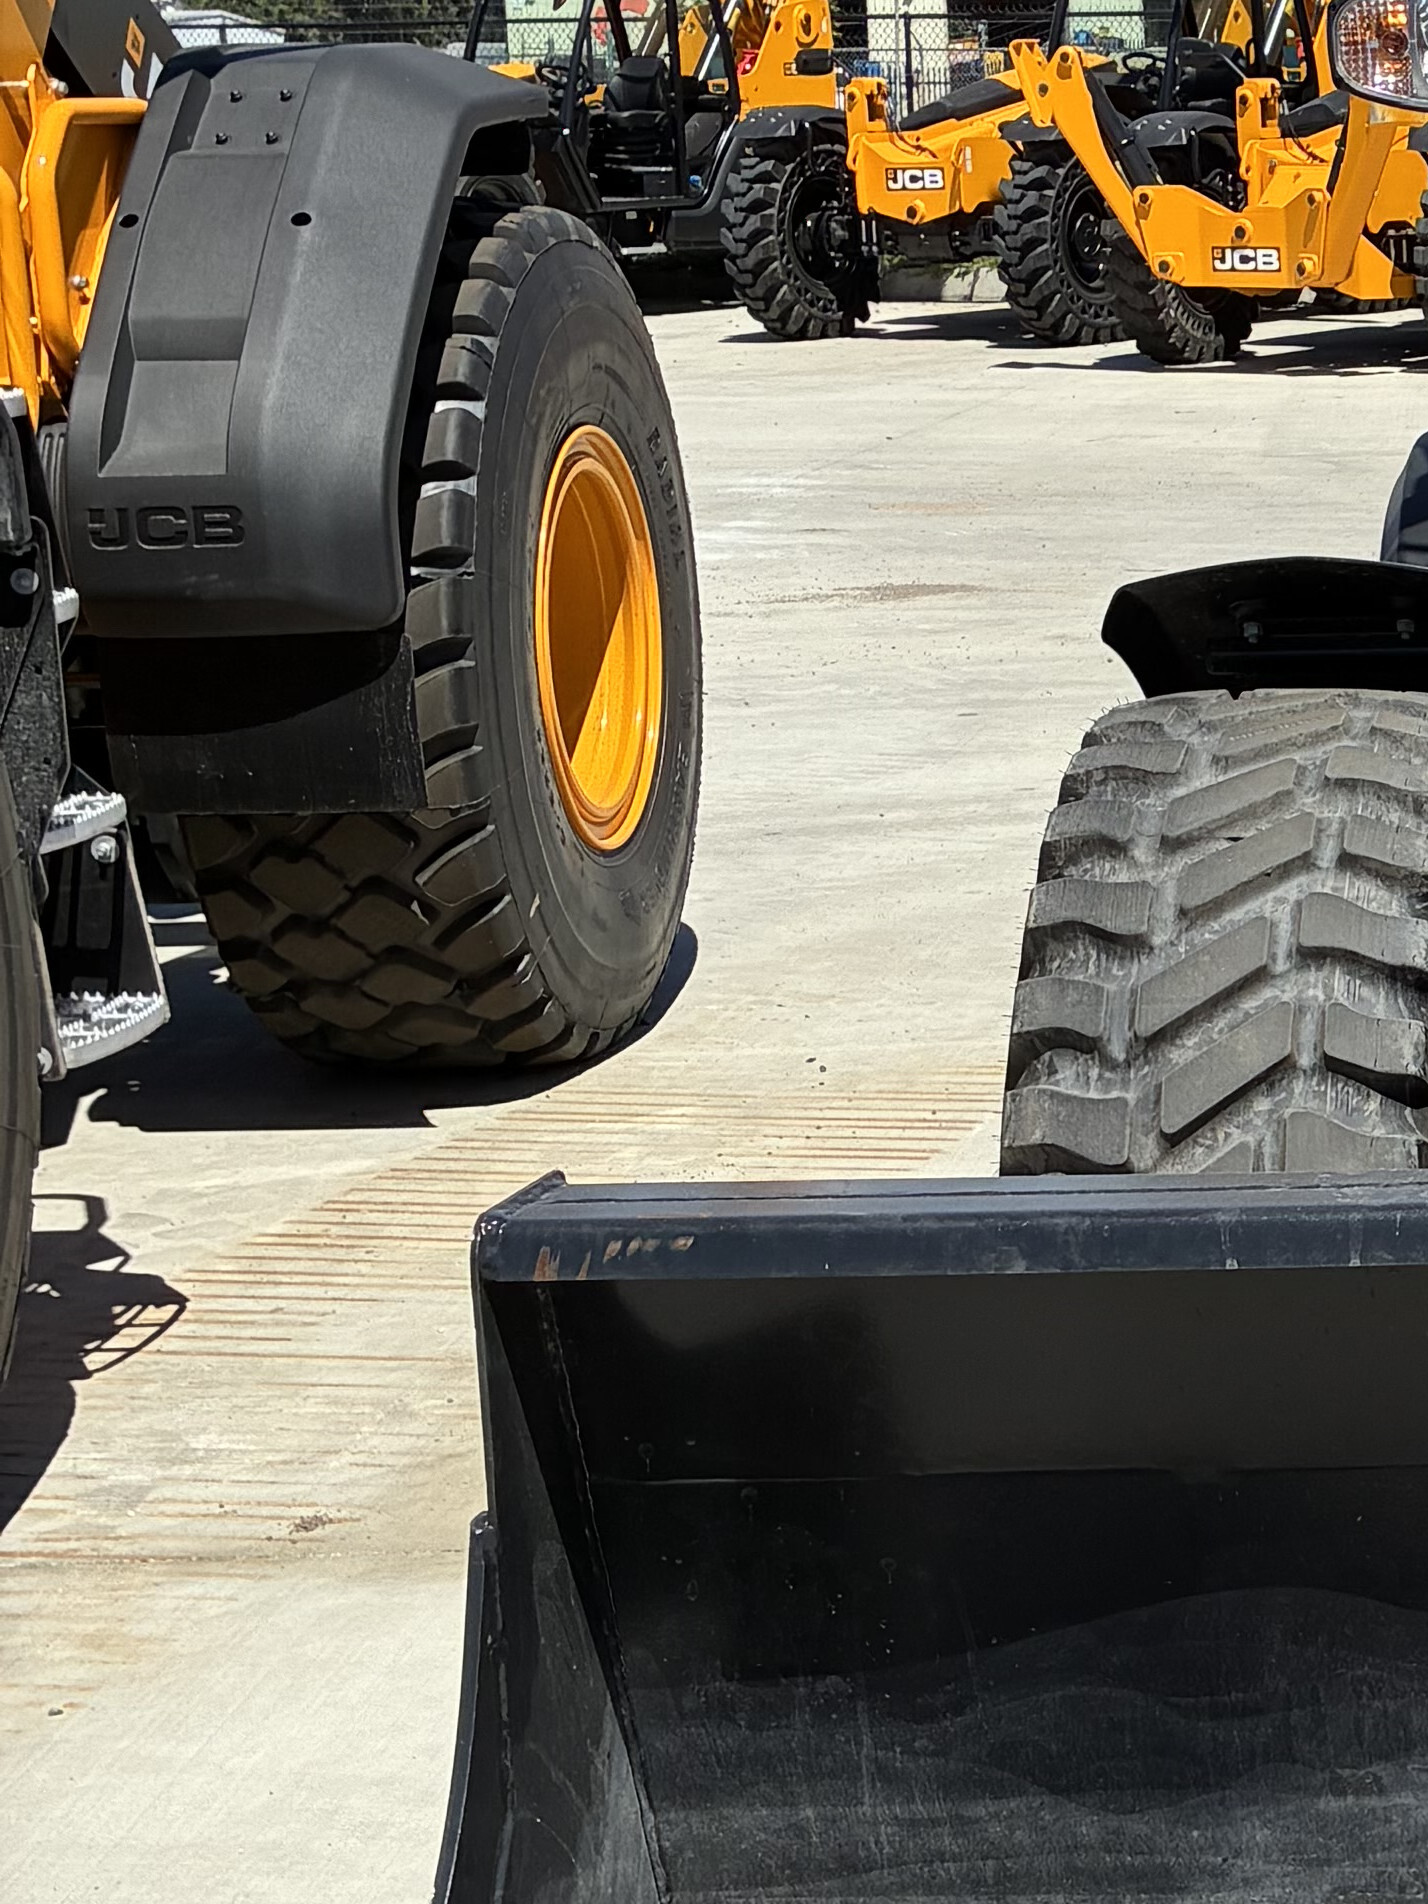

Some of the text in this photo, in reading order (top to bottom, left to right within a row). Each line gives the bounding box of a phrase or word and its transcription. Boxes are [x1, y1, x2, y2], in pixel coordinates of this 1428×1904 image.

[887, 168, 944, 189] JCB
[1213, 248, 1280, 270] JCB
[88, 506, 245, 551] JCB
